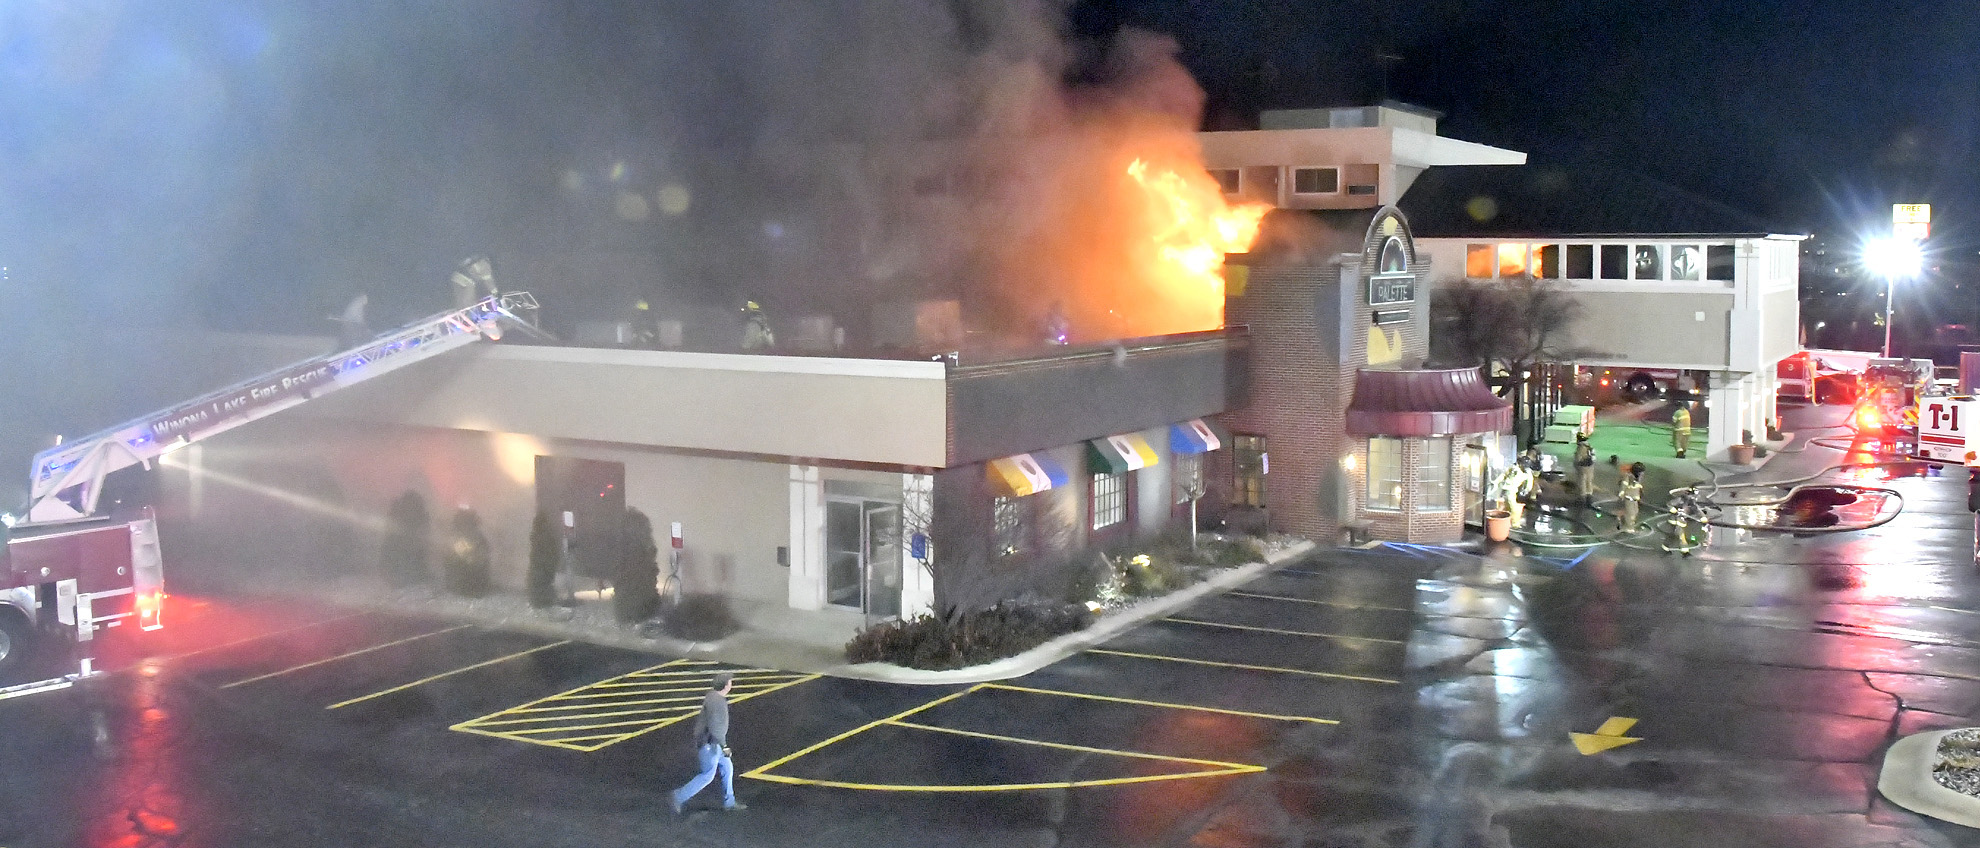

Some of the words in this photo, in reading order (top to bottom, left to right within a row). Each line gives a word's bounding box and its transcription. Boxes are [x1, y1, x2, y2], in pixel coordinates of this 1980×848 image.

[1379, 285, 1408, 301] PALETTE
[153, 410, 208, 435] WINONA
[213, 396, 247, 415] LAKE
[251, 383, 278, 401] FIRE
[282, 366, 328, 390] RESCUE
[1928, 403, 1959, 431] T-1
